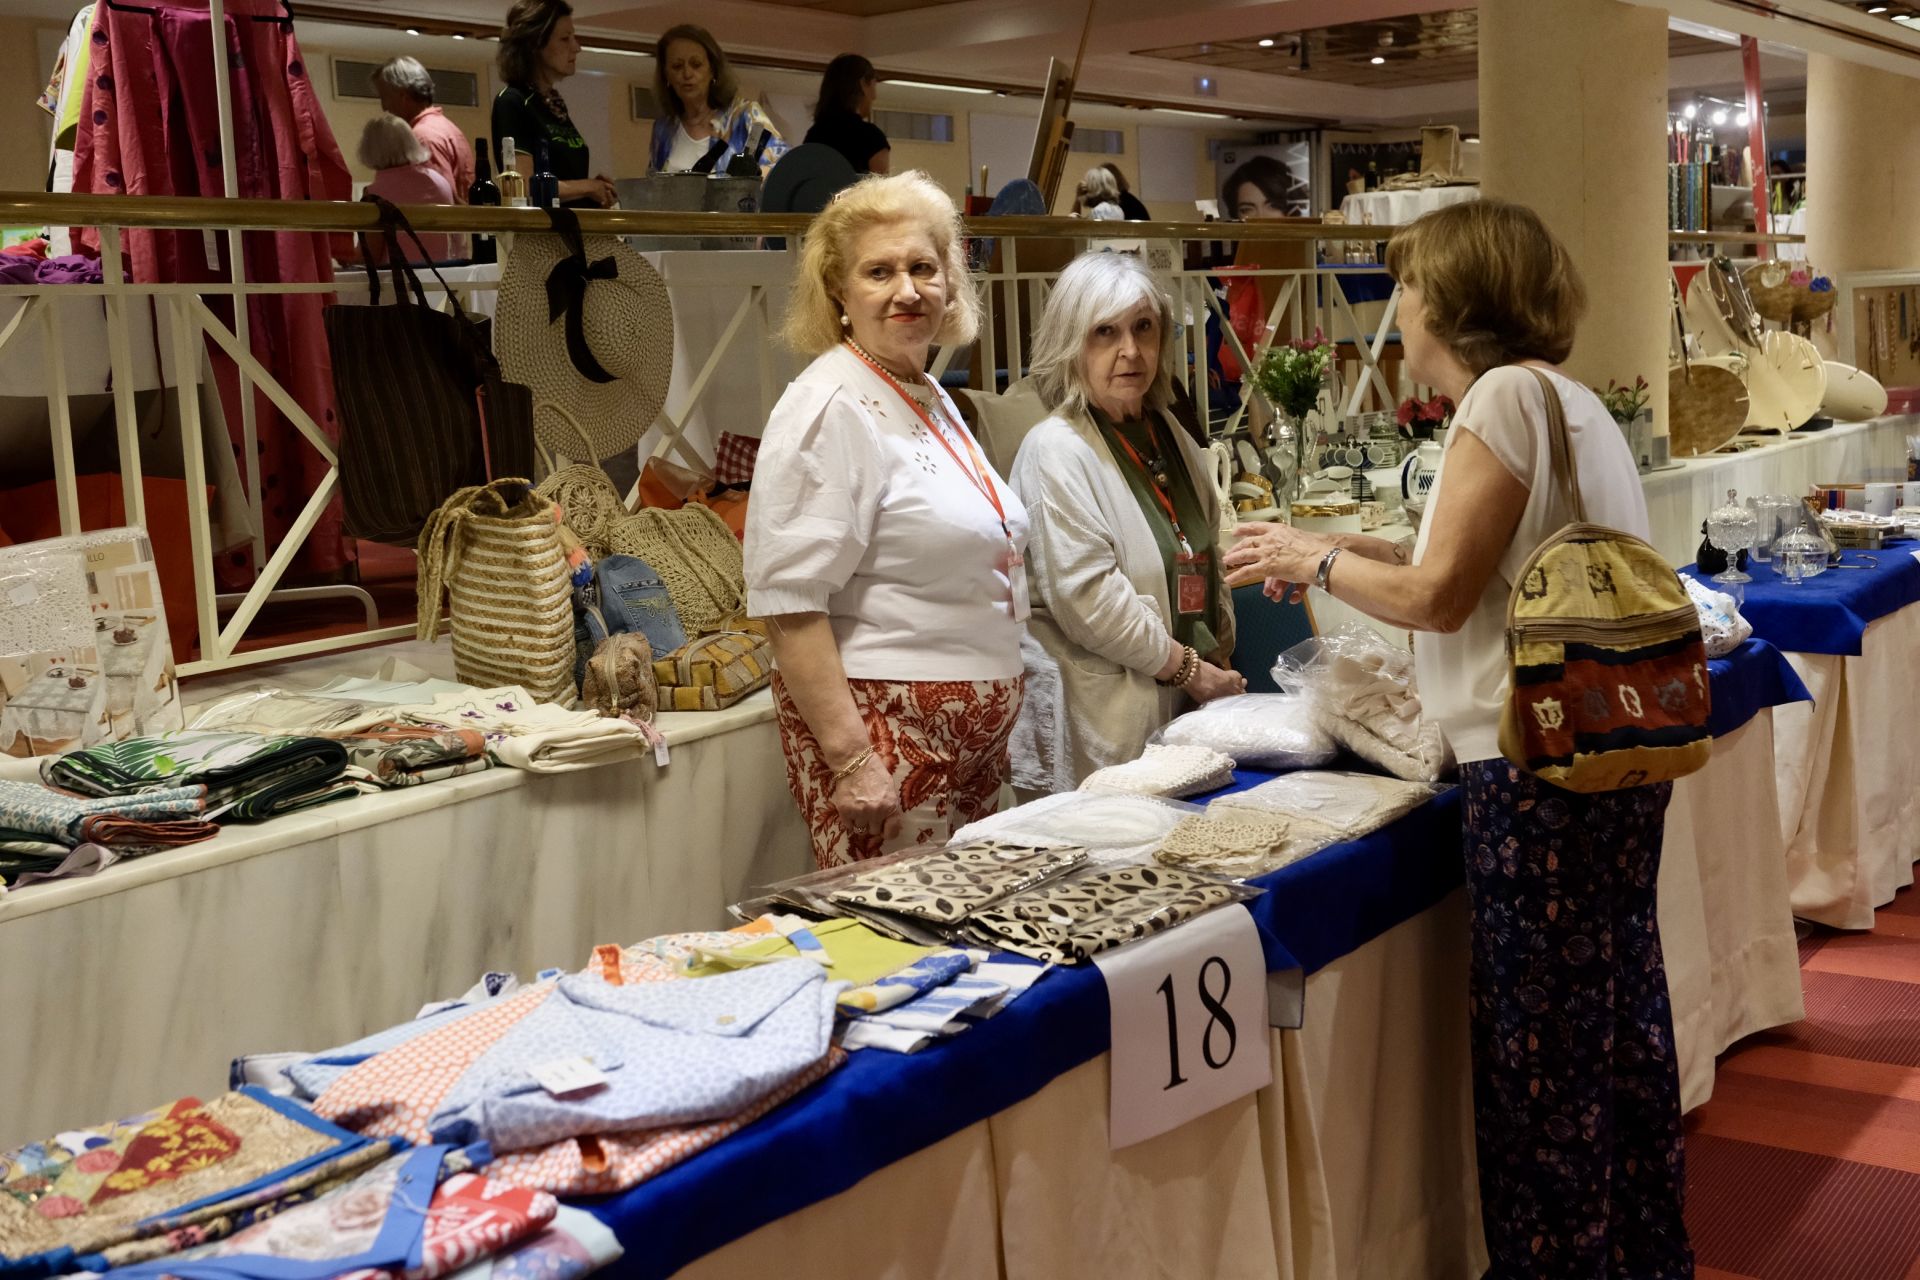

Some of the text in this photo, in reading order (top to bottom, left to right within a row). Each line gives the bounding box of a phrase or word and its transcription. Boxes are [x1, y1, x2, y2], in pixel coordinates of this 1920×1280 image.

[1330, 143, 1379, 156] MARY
[1286, 141, 1310, 217] MAR
[87, 552, 105, 562] ILLO
[1156, 956, 1236, 1091] 18
